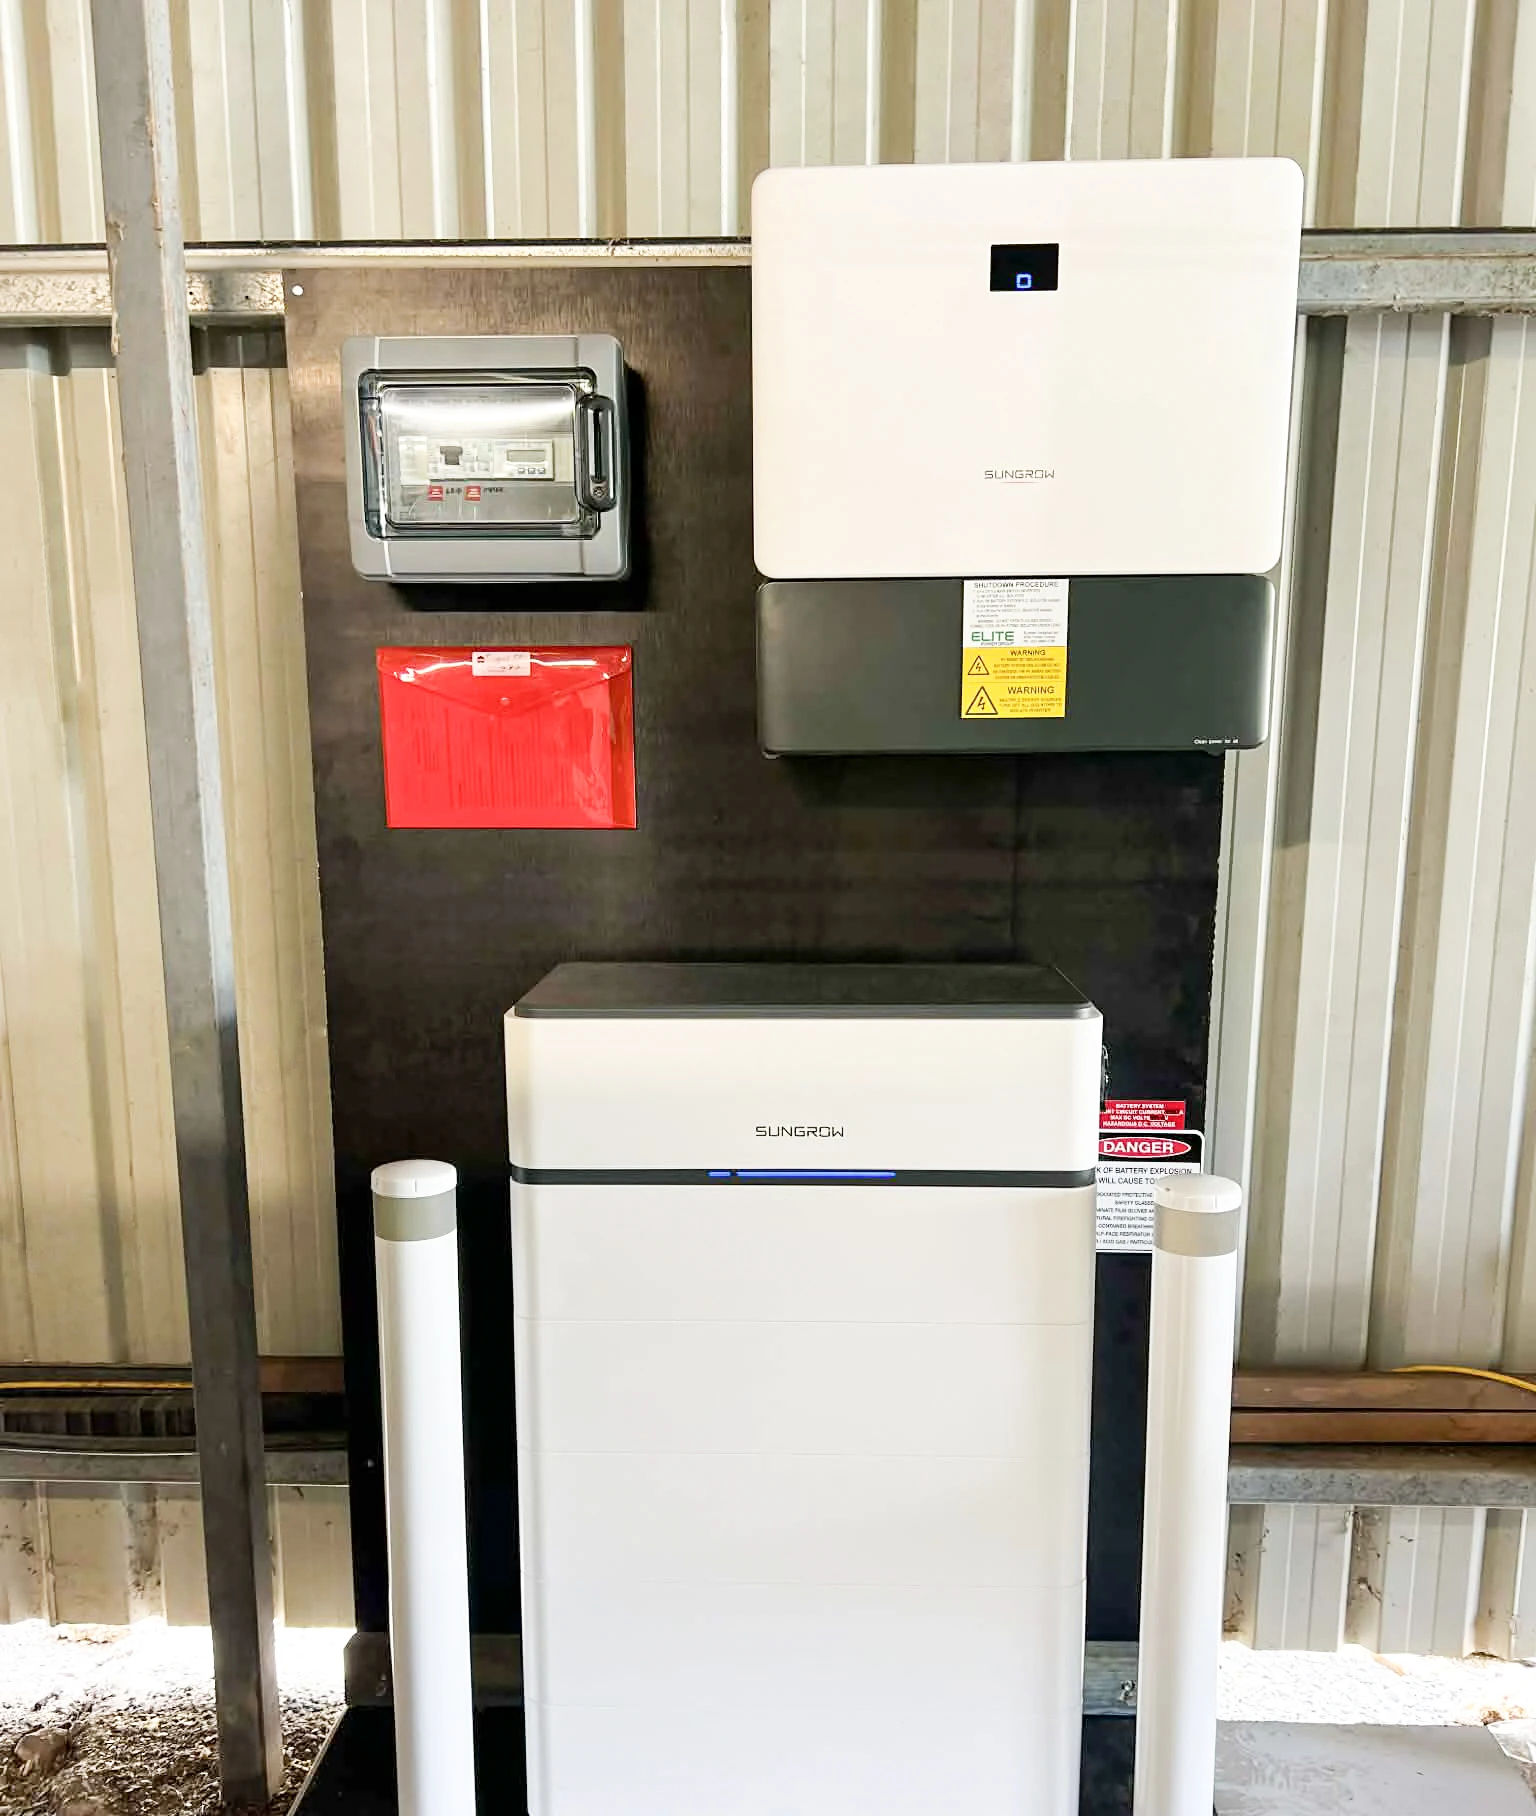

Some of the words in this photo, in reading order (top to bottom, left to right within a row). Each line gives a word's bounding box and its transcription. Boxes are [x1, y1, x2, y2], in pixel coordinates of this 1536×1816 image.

[984, 469, 1055, 480] SUNGROW
[971, 631, 1015, 642] ELITE
[1010, 649, 1046, 657] WARNING
[1007, 686, 1055, 694] WARNING
[755, 1125, 844, 1138] SUNGROW
[1103, 1141, 1174, 1154] DANGER
